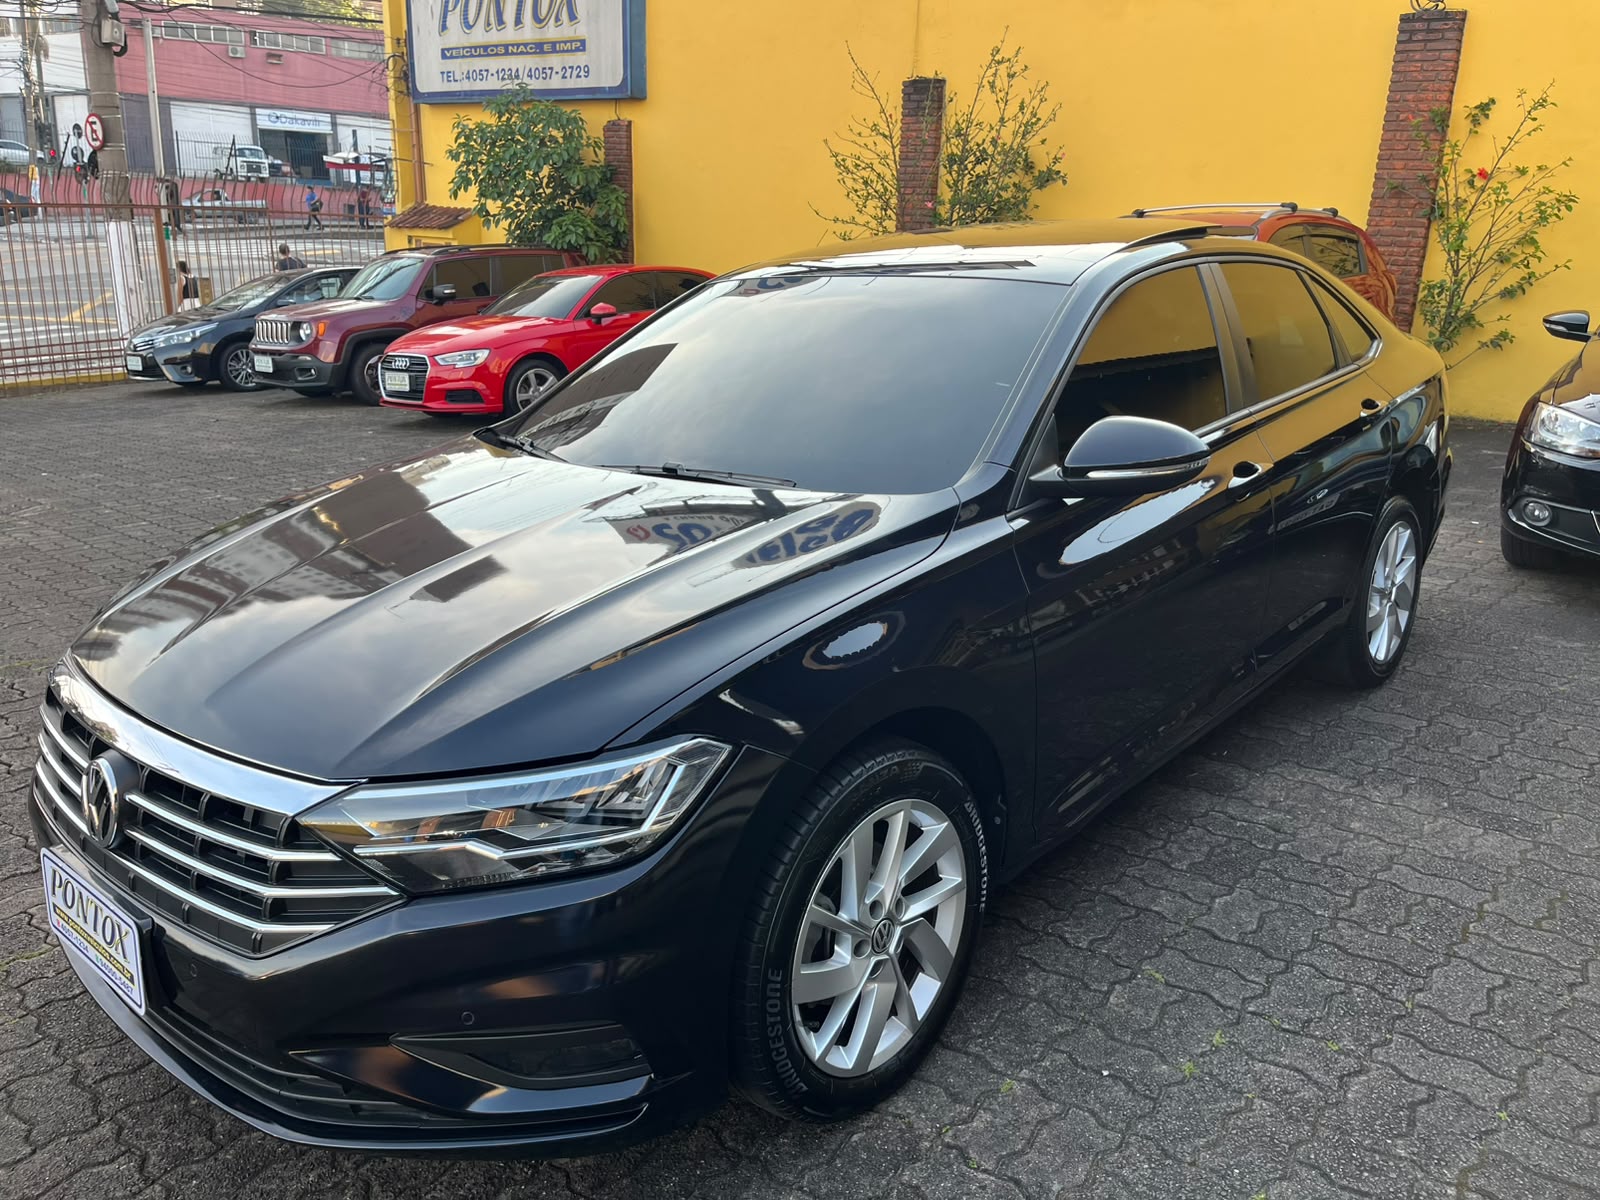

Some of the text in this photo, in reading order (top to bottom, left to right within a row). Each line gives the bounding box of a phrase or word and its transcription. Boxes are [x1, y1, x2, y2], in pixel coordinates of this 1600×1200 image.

[508, 44, 540, 53] NAC.
[543, 43, 552, 52] E
[556, 41, 583, 51] IMP.
[50, 866, 131, 964] PONTOX
